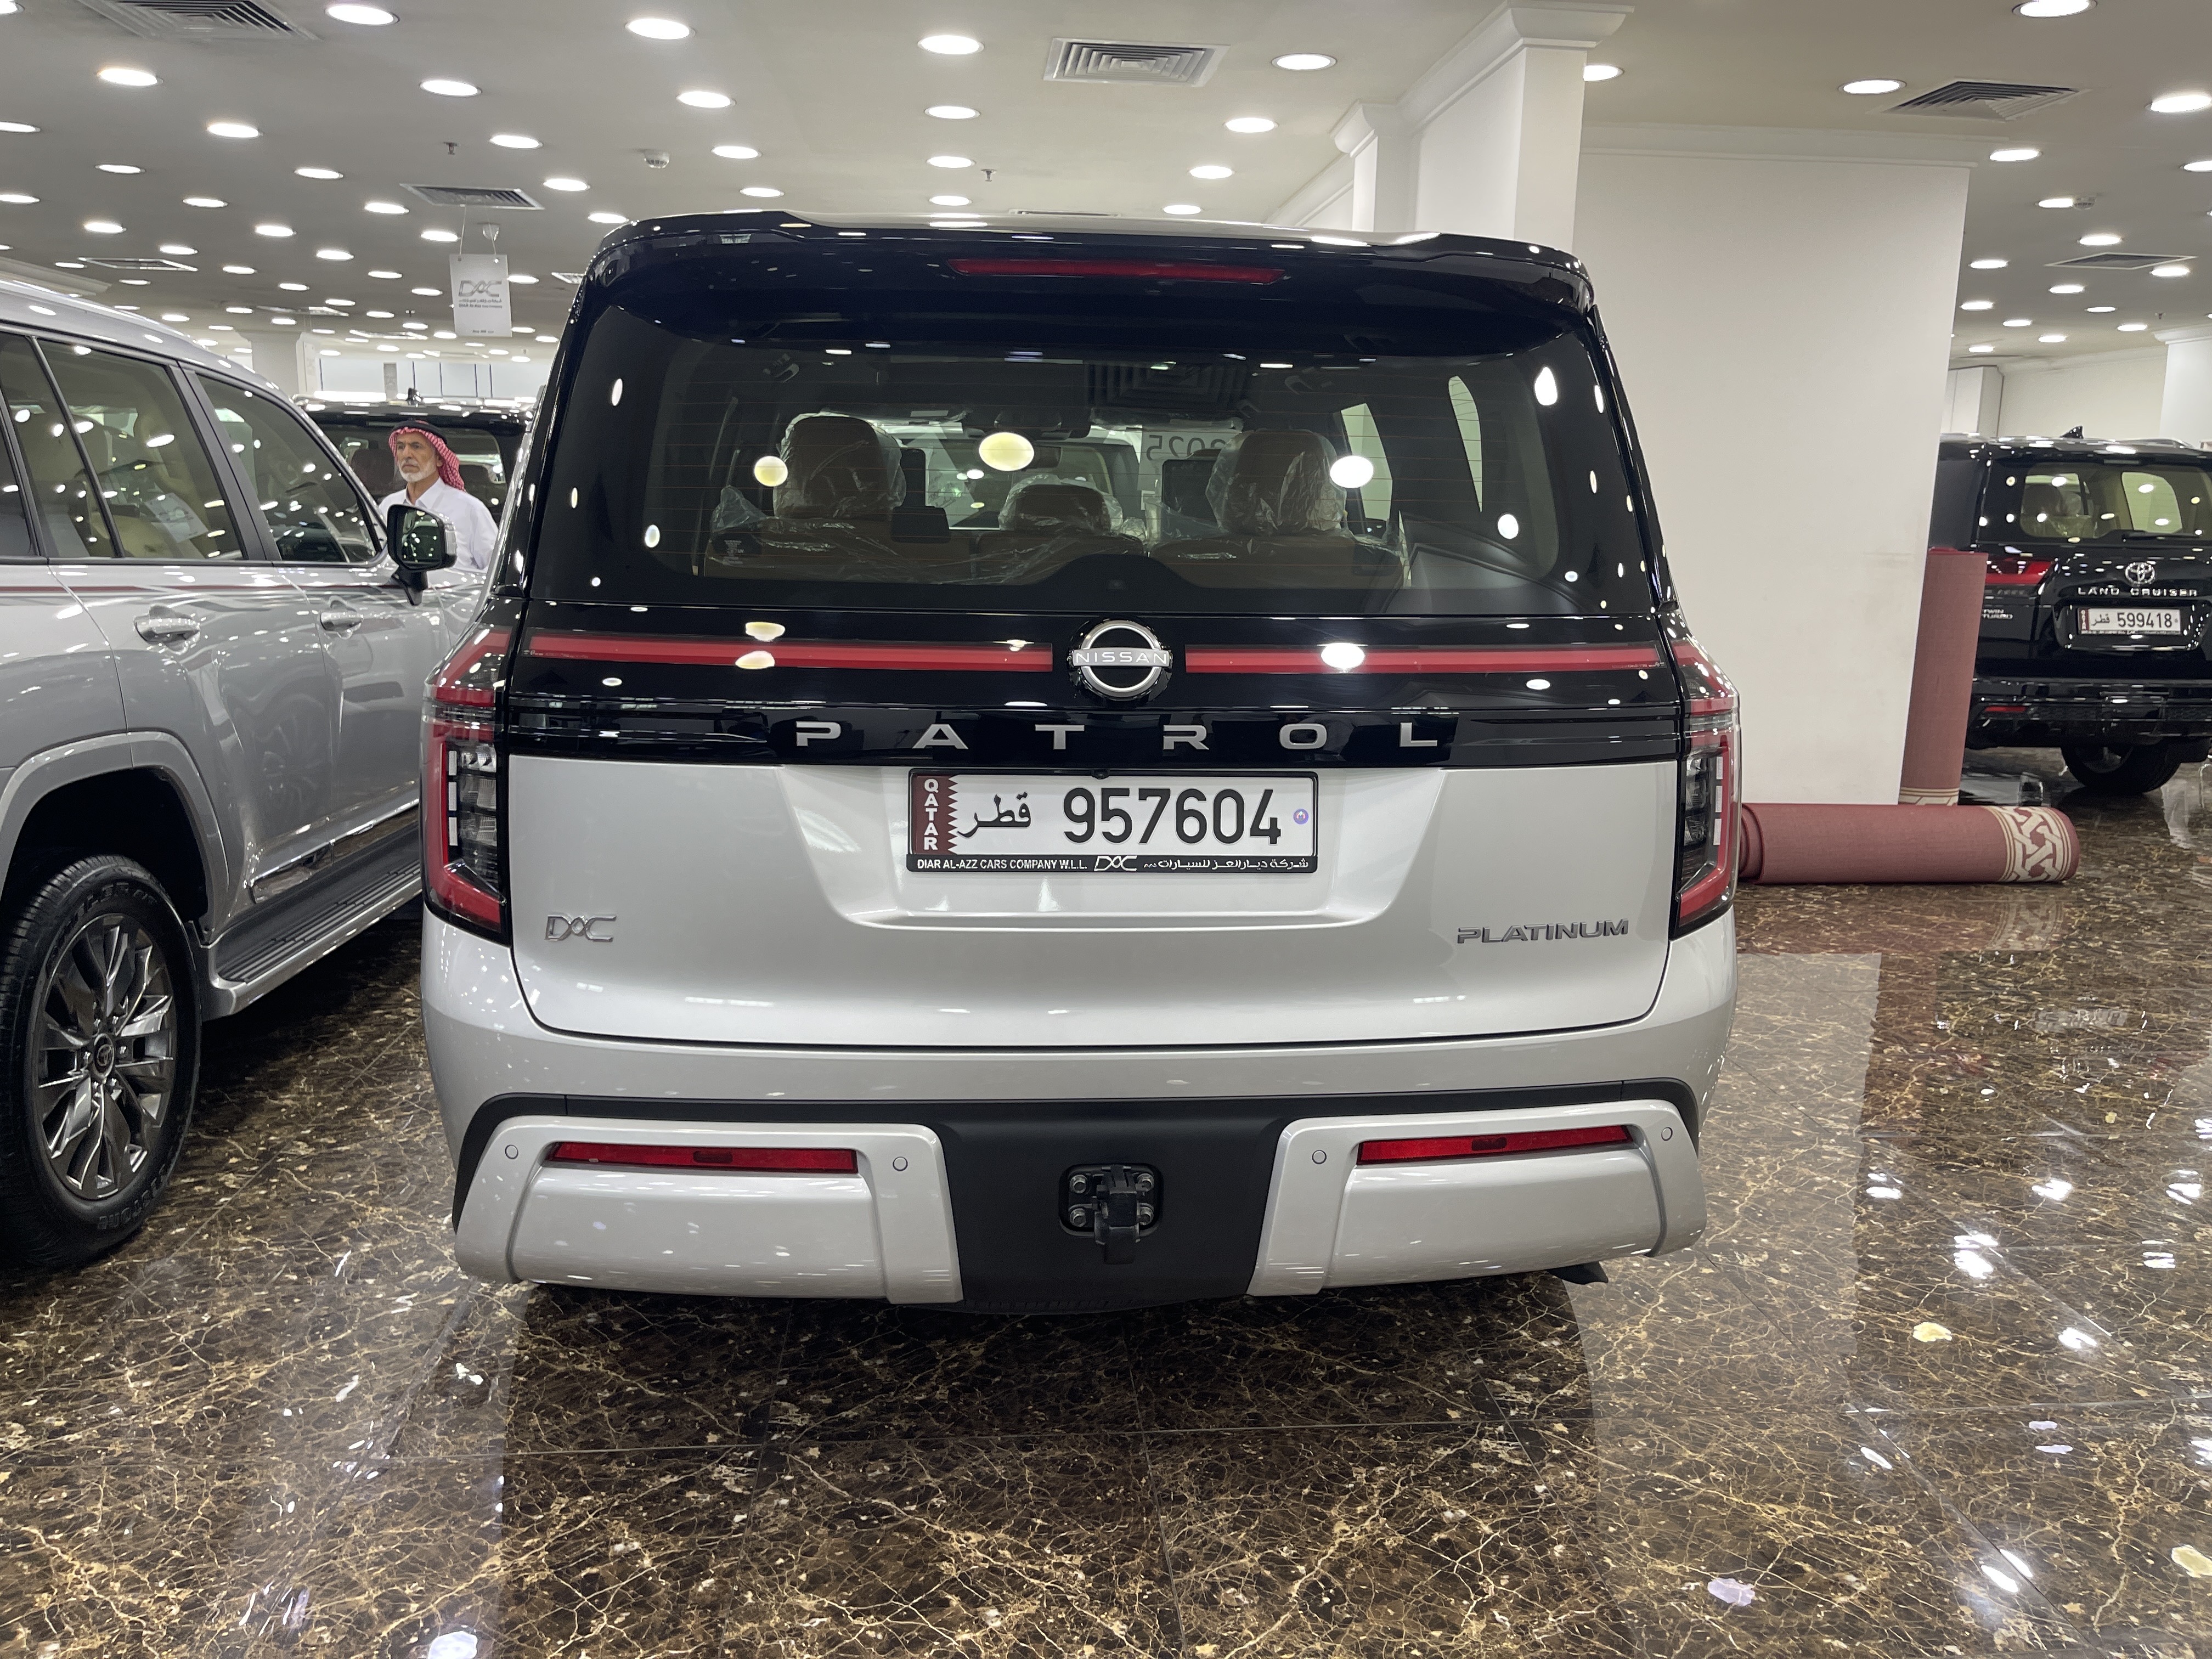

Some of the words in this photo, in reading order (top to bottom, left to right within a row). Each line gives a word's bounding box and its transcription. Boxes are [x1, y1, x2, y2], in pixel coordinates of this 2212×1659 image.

[2078, 587, 2120, 596] LAND
[2130, 588, 2198, 597] CRUISER
[2091, 613, 2110, 626] قطر
[2117, 612, 2173, 628] 599418
[1076, 651, 1167, 664] NISSAN
[795, 720, 1438, 749] PATROL
[923, 778, 939, 851] QATAR
[956, 791, 1031, 838] قطر
[1063, 787, 1282, 844] 957604
[917, 859, 941, 869] DIAR
[943, 859, 978, 869] AL-AZZ
[980, 859, 1007, 869] CARS
[1009, 859, 1058, 869] COMPANY
[1059, 859, 1088, 869] W.L.L.
[1158, 859, 1210, 870] للسيارات
[1269, 857, 1309, 870] شركة
[1457, 918, 1629, 944] PLATINUM
